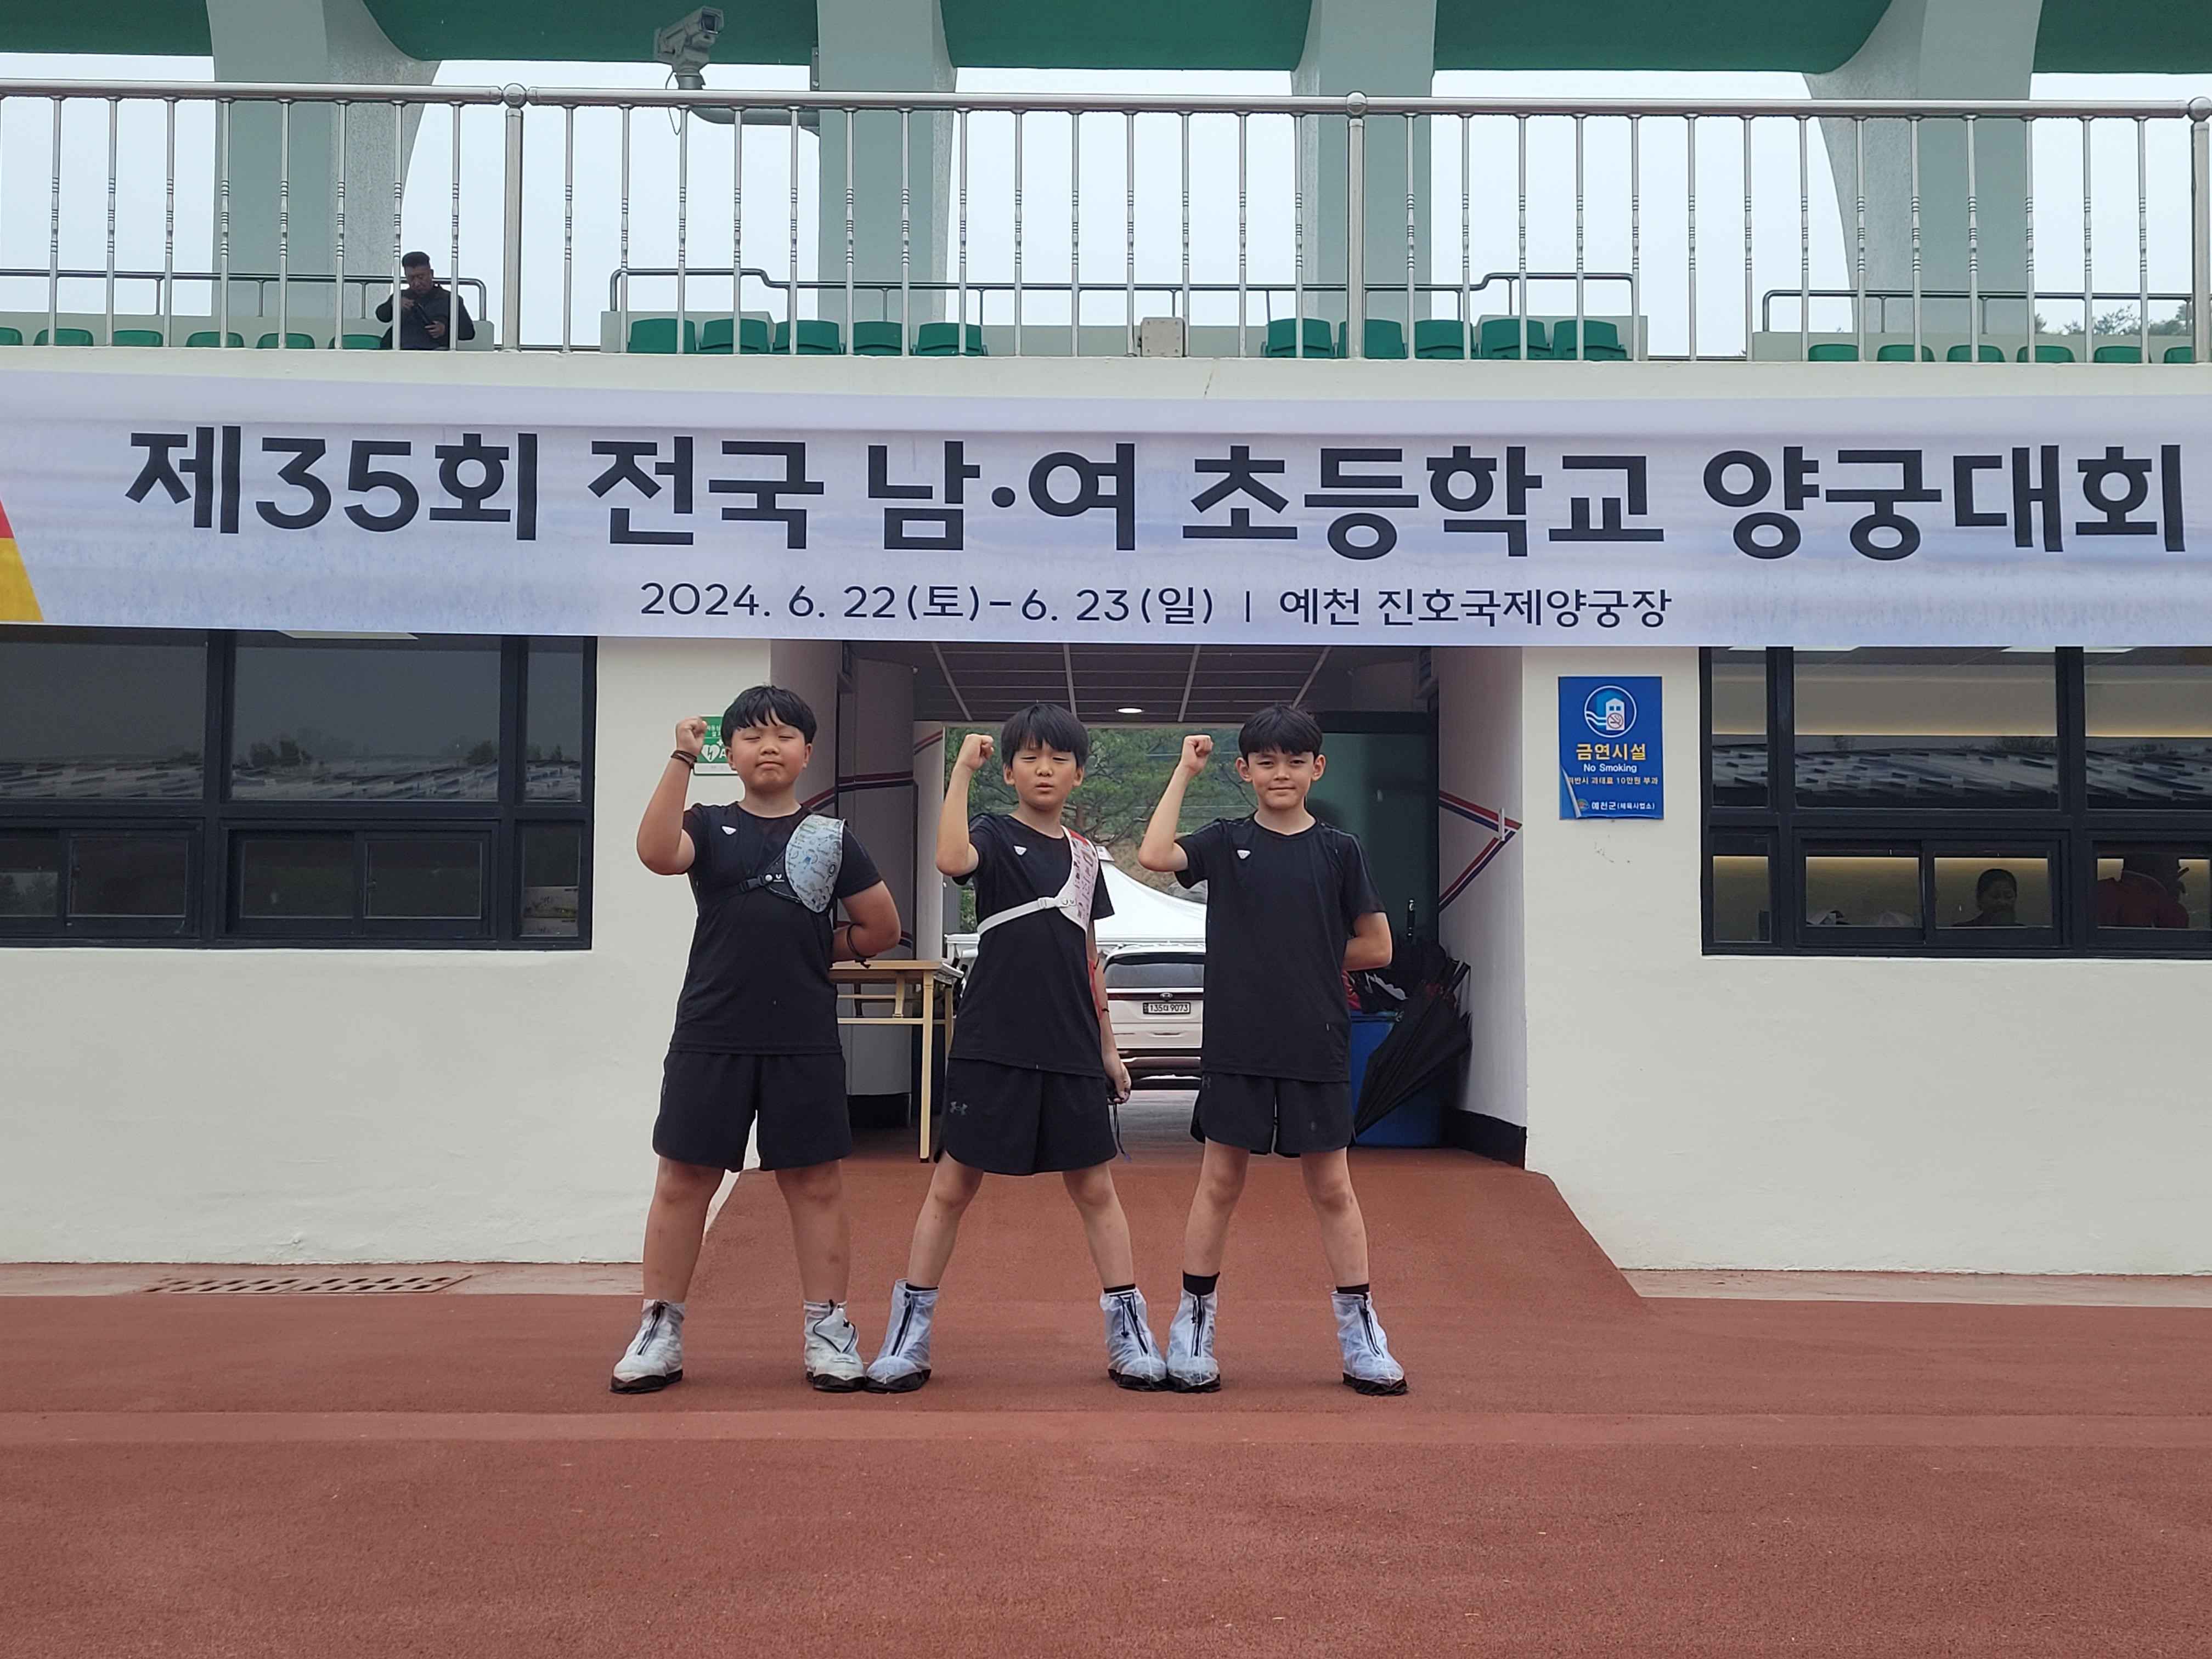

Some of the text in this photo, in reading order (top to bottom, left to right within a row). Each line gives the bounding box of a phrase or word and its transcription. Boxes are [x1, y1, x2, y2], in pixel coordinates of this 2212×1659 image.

[124, 425, 538, 541] 제35회
[587, 436, 825, 550] 전국
[1182, 444, 1665, 561] 초등학교
[1702, 444, 2186, 561] 양궁대회
[640, 582, 771, 617] 2024.
[788, 584, 826, 618] 6.
[1076, 586, 1213, 625] 23(일)
[1279, 588, 1360, 626] 예천
[1378, 588, 1673, 629] 진호국제양궁장
[1576, 743, 1646, 760] 금연시설
[1583, 763, 1638, 773] No Smoking
